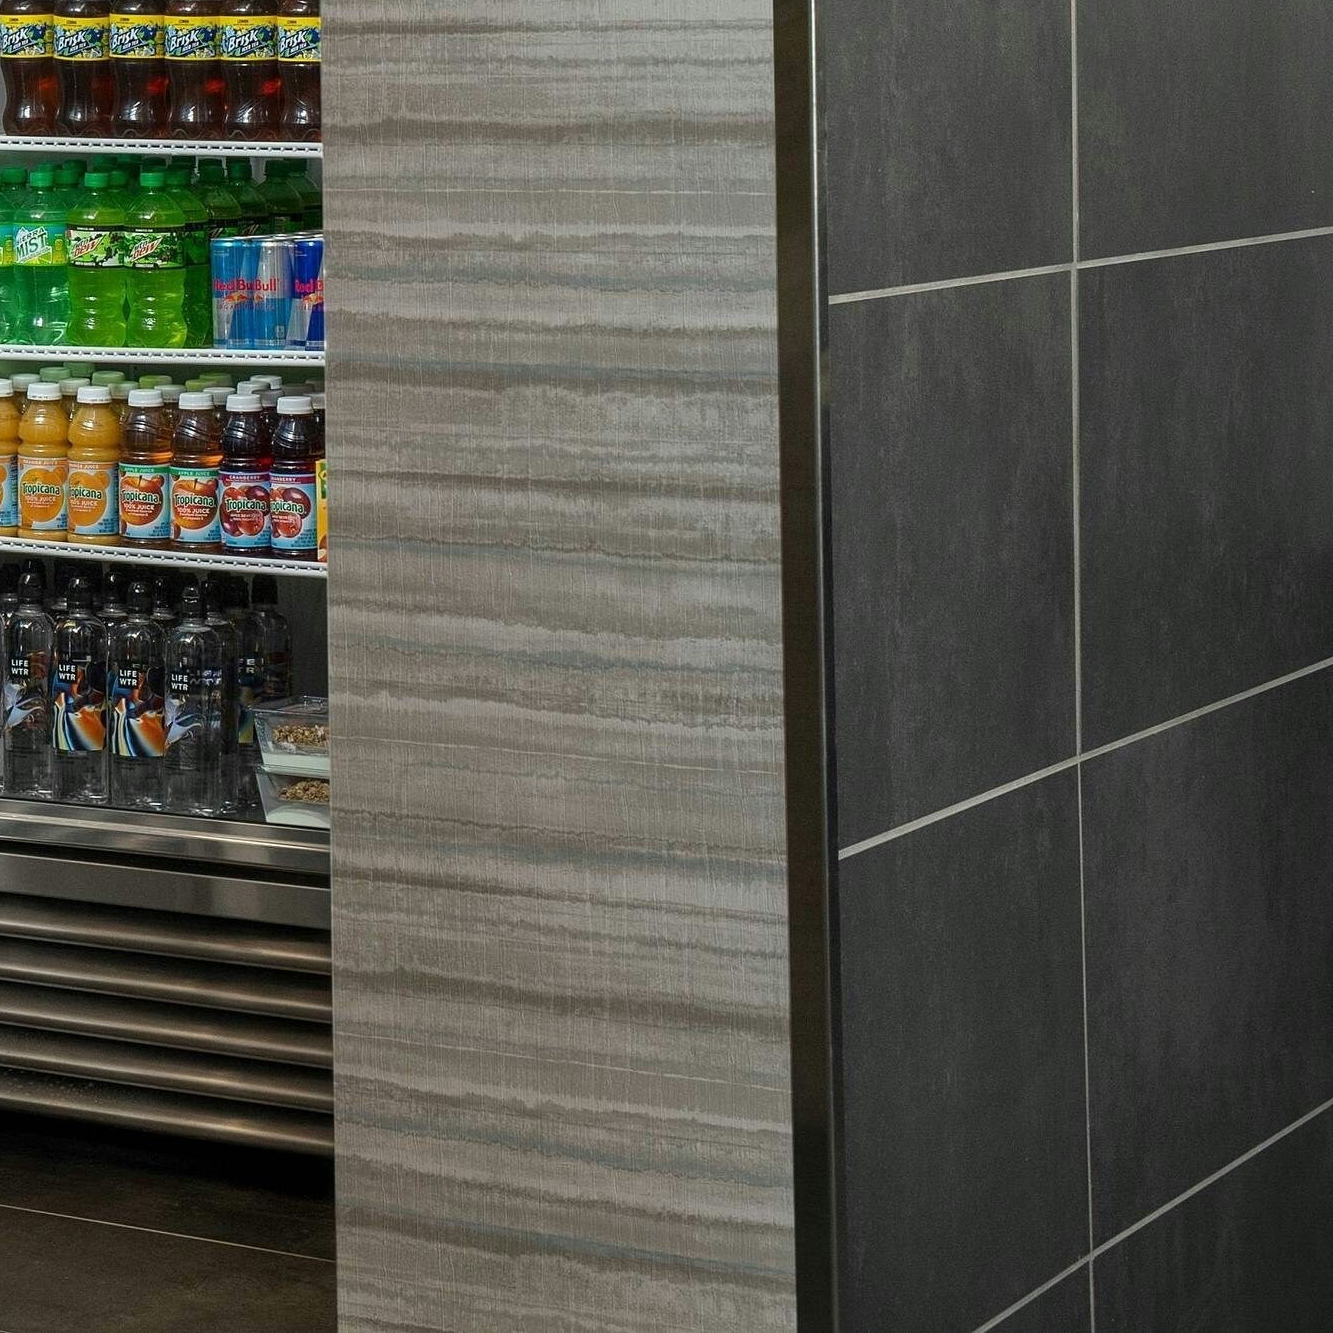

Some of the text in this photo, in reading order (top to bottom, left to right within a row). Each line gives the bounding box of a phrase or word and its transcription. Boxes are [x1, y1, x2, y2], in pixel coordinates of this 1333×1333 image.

[16, 235, 50, 258] MIST
[237, 278, 254, 292] Bu
[255, 276, 277, 292] Bull
[23, 481, 61, 496] Tropicana
[71, 485, 103, 500] opicana
[122, 489, 160, 504] Tropicana
[175, 493, 215, 507] Tropicana
[226, 497, 267, 512] Tropicana
[270, 499, 305, 515] opicana
[192, 507, 211, 515] JUICE
[11, 659, 29, 668] LIFE
[59, 664, 77, 673] LIFE
[11, 668, 29, 676] WTR
[59, 672, 77, 681] WTR
[119, 669, 137, 678] LIFE
[171, 673, 189, 682] LIFE
[119, 677, 137, 686] WTR
[171, 681, 189, 690] WTR
